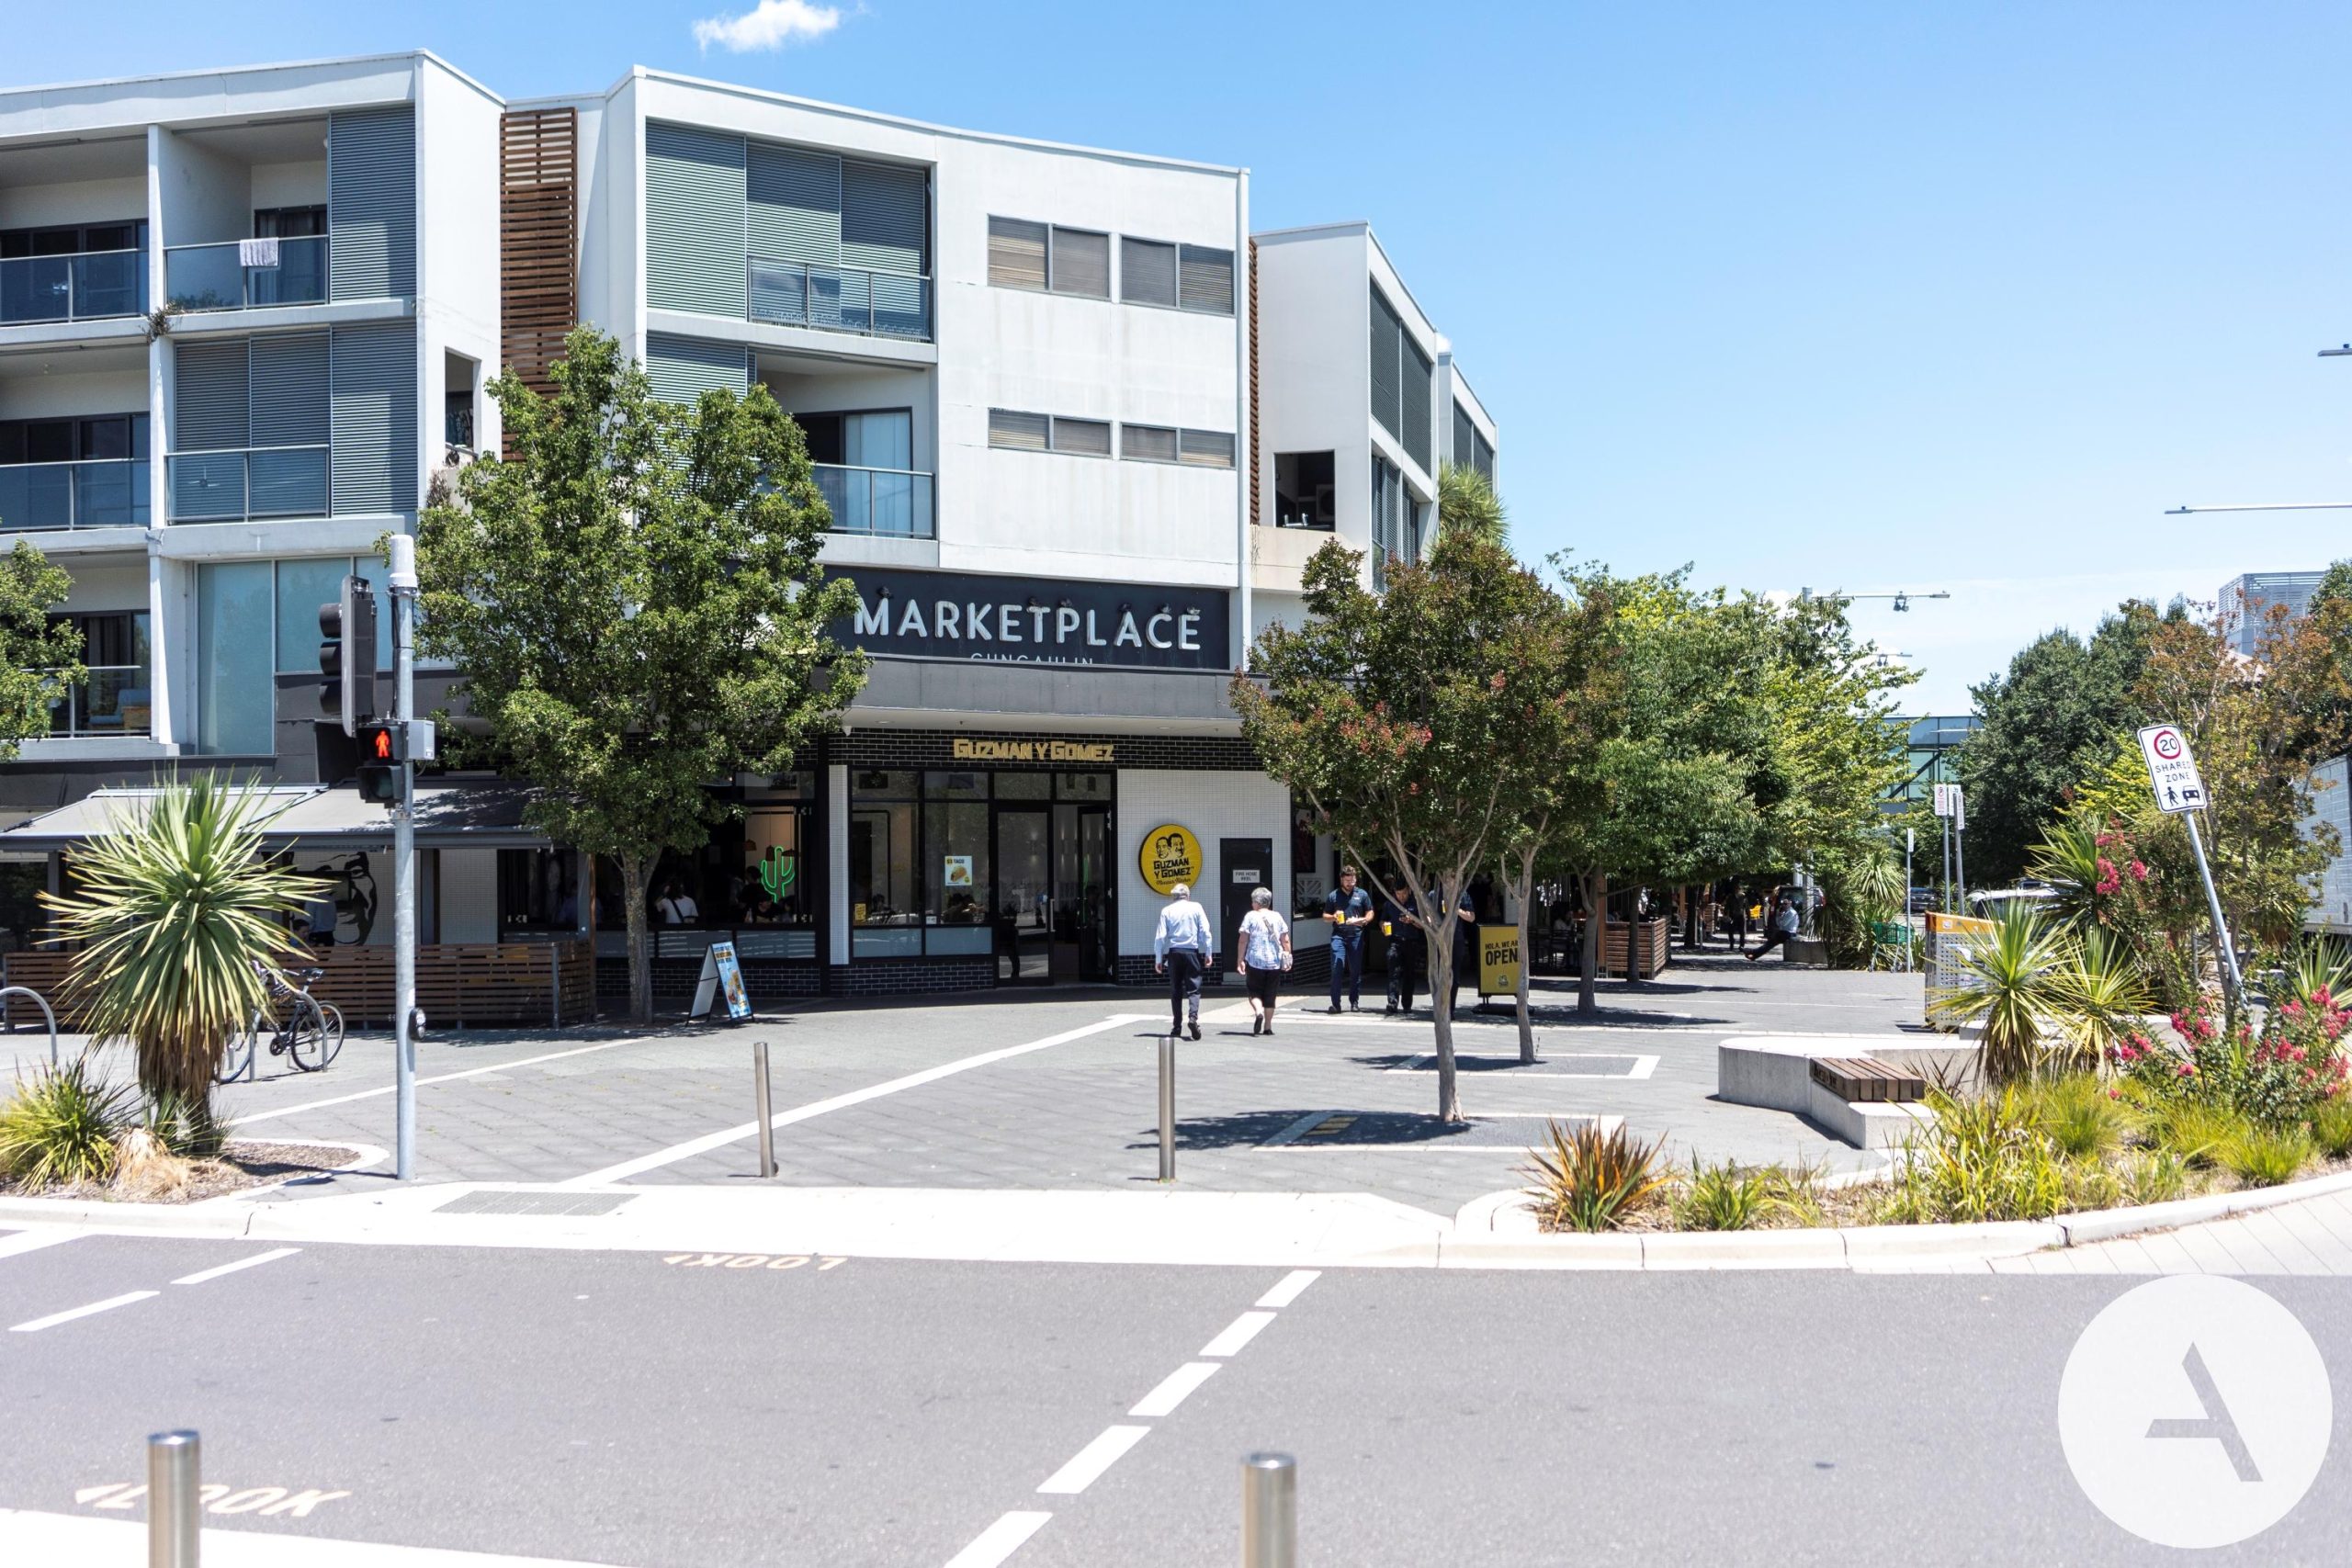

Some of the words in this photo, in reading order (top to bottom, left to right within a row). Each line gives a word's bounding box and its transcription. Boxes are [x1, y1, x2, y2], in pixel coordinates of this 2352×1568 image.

[854, 597, 1201, 650] MARKETPLACE
[954, 739, 1033, 760] GUZMAN
[1035, 742, 1049, 761] Y
[1050, 741, 1114, 761] GOMEZ
[2160, 739, 2177, 751] 20
[2155, 761, 2191, 773] SHARED
[2165, 773, 2190, 783] ZONE
[1153, 857, 1189, 870] GUZMAN
[1154, 870, 1160, 879] Y
[1161, 867, 1191, 878] GOMEZ
